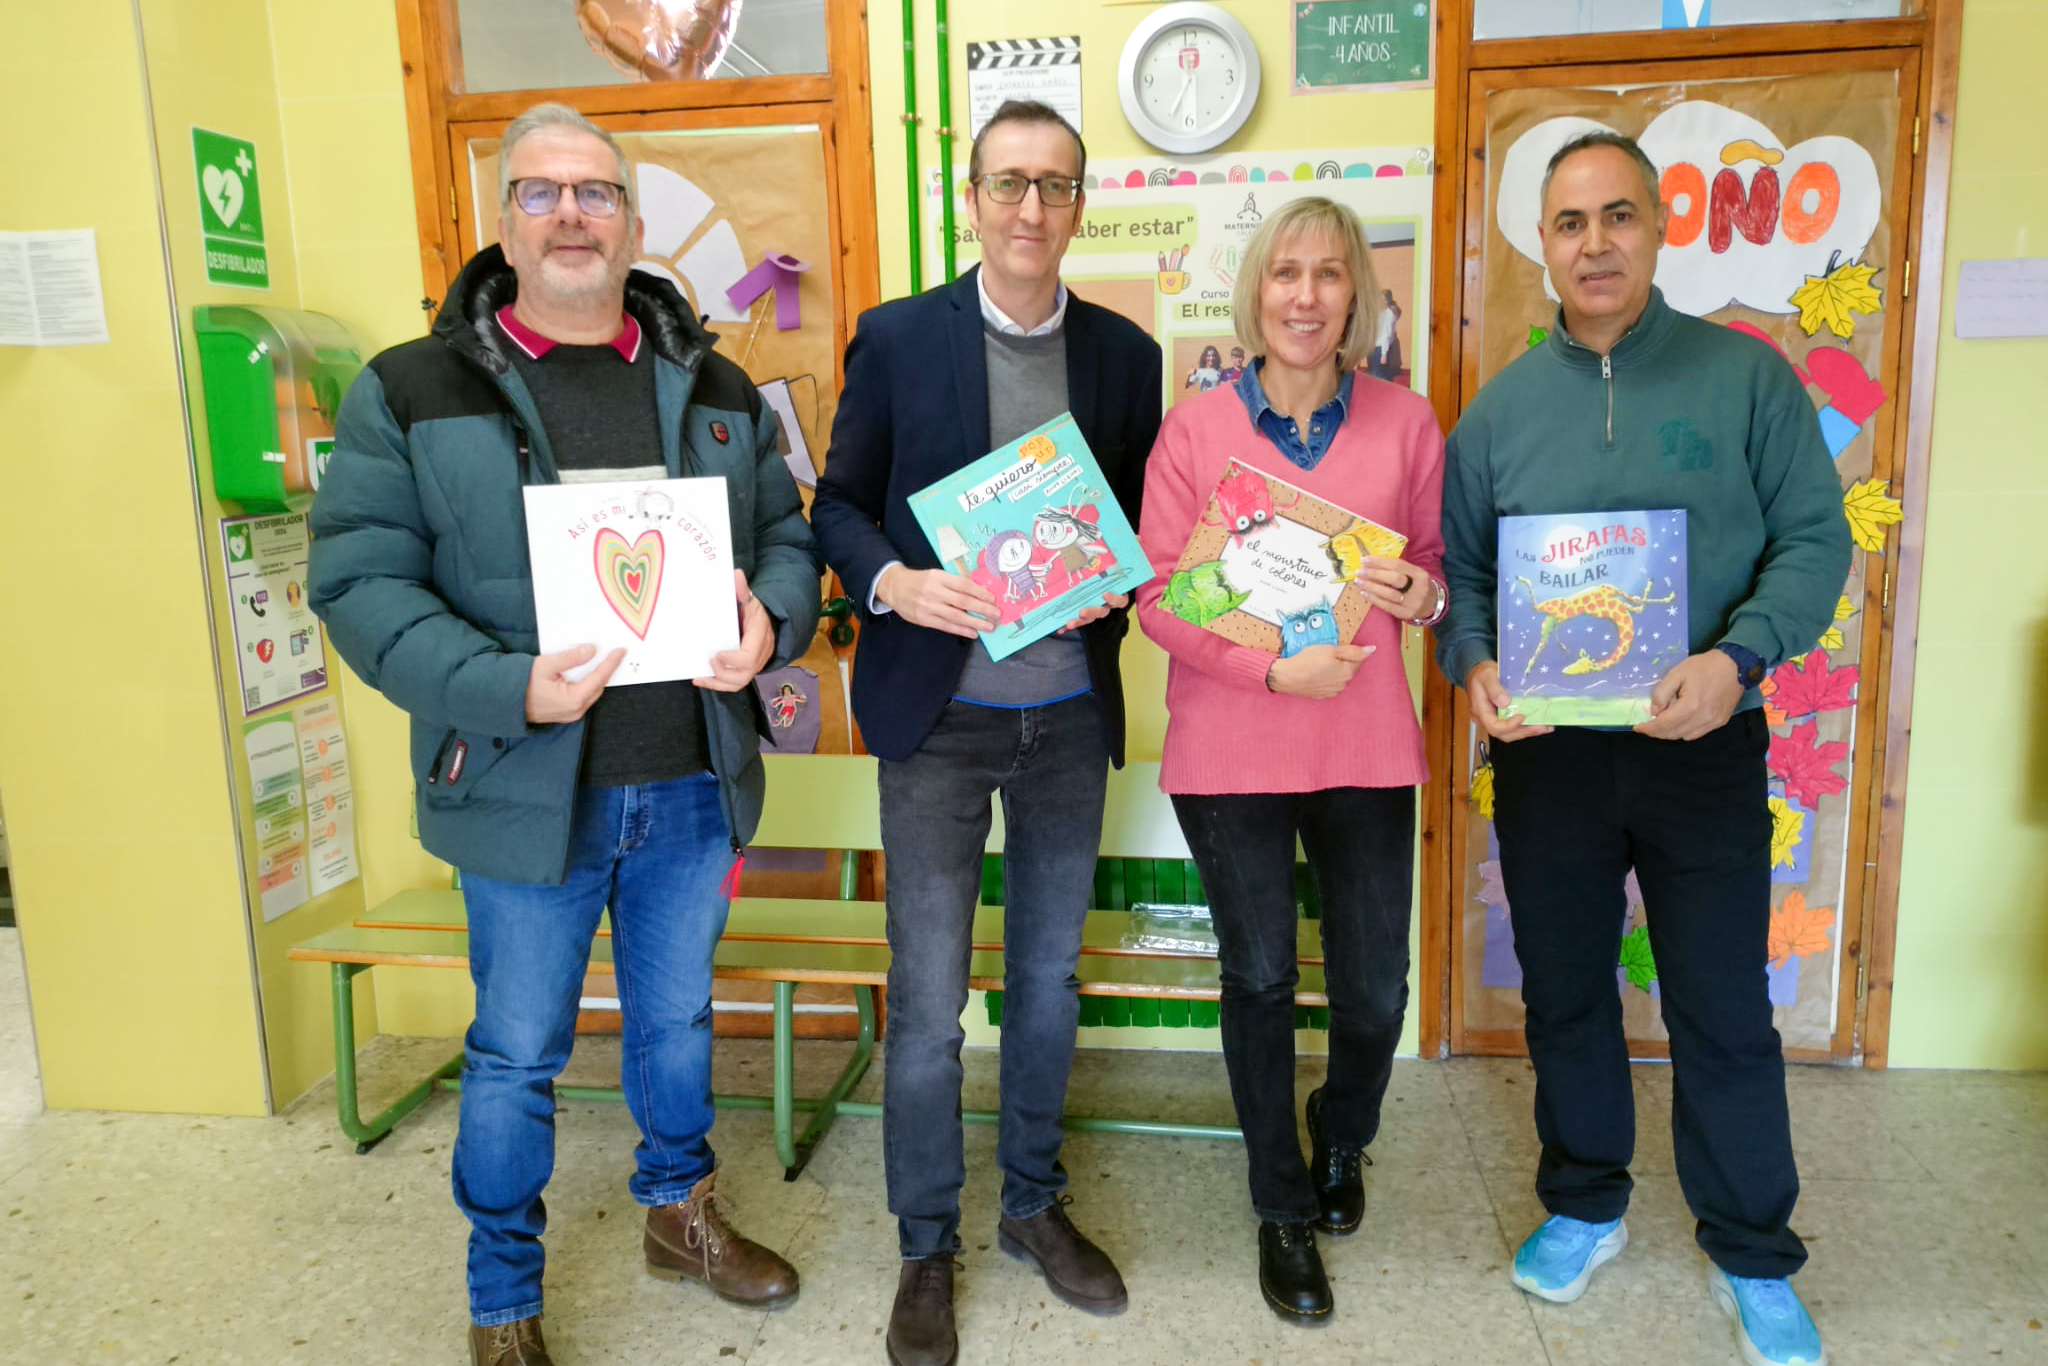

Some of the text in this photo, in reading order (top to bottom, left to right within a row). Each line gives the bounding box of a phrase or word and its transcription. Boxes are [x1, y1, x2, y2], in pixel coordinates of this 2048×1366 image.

[1328, 12, 1400, 36] INFANTIL
[1182, 30, 1198, 47] 12
[1347, 40, 1391, 63] AÑOS
[1144, 73, 1154, 89] 9
[1226, 68, 1234, 86] 3
[1184, 114, 1195, 128] 6
[1658, 138, 1841, 254] OÑO
[1074, 219, 1122, 239] aber
[1129, 215, 1194, 237] estar"
[1224, 222, 1264, 231] MATERNI
[207, 250, 267, 275] DESFIBRILADOR
[1200, 290, 1230, 299] Curso
[1182, 303, 1232, 318] El res
[985, 459, 1037, 504] quiero
[592, 510, 608, 523] es
[611, 505, 626, 515] mi
[677, 517, 717, 561] corazón
[1515, 524, 1647, 563] LAS JIRAFAS
[1247, 540, 1328, 580] el monstruo
[1596, 546, 1635, 561] PUEDEN
[1251, 558, 1263, 570] de
[1268, 566, 1307, 589] colores
[1539, 563, 1609, 588] BAILAR
